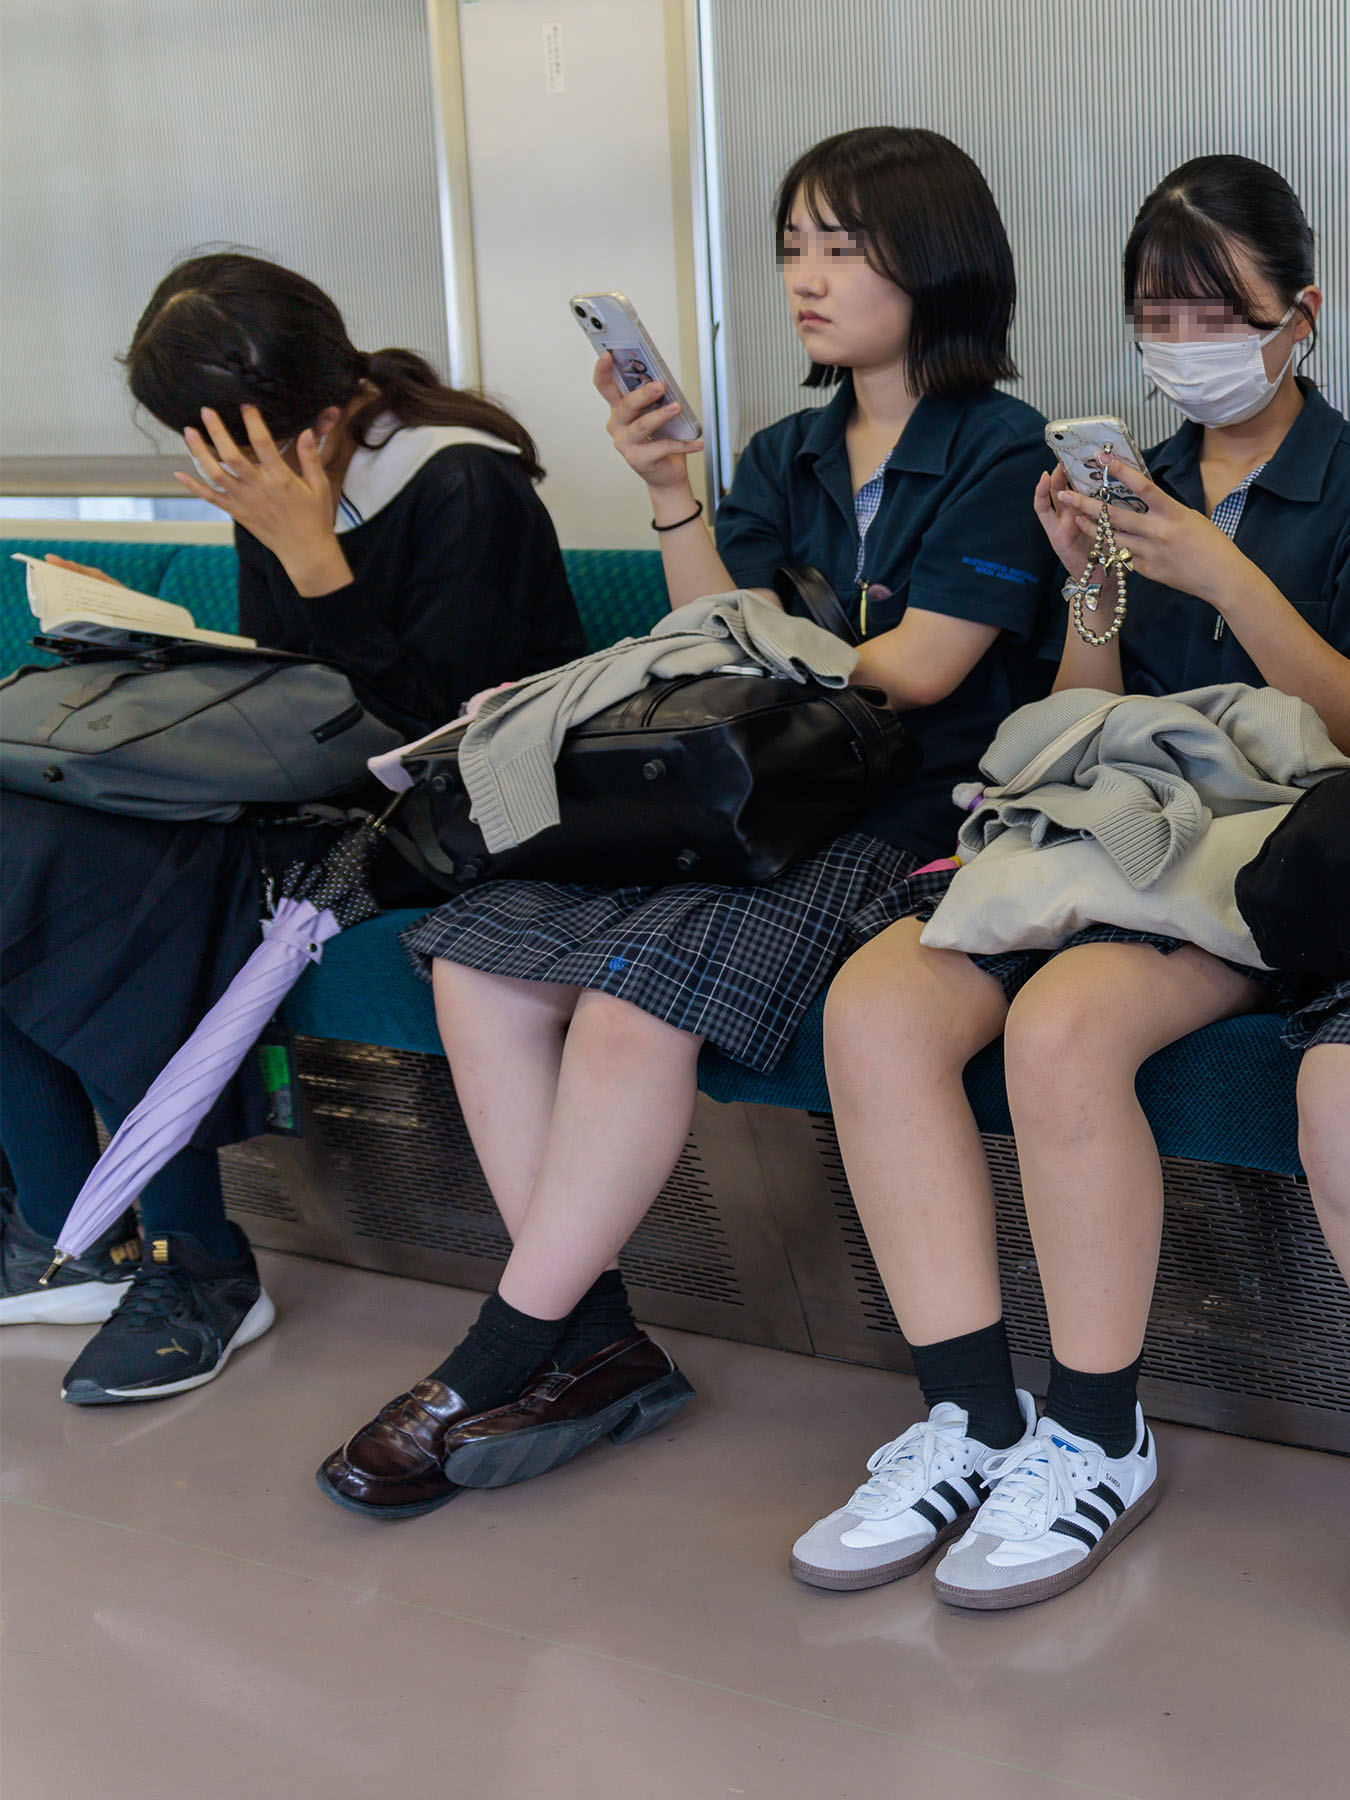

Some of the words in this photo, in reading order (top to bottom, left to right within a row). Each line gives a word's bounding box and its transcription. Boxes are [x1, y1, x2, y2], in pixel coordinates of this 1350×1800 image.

[962, 556, 1007, 573] MATSUMOTO
[974, 566, 995, 577] HIGH
[1105, 1473, 1121, 1488] SAMBA
